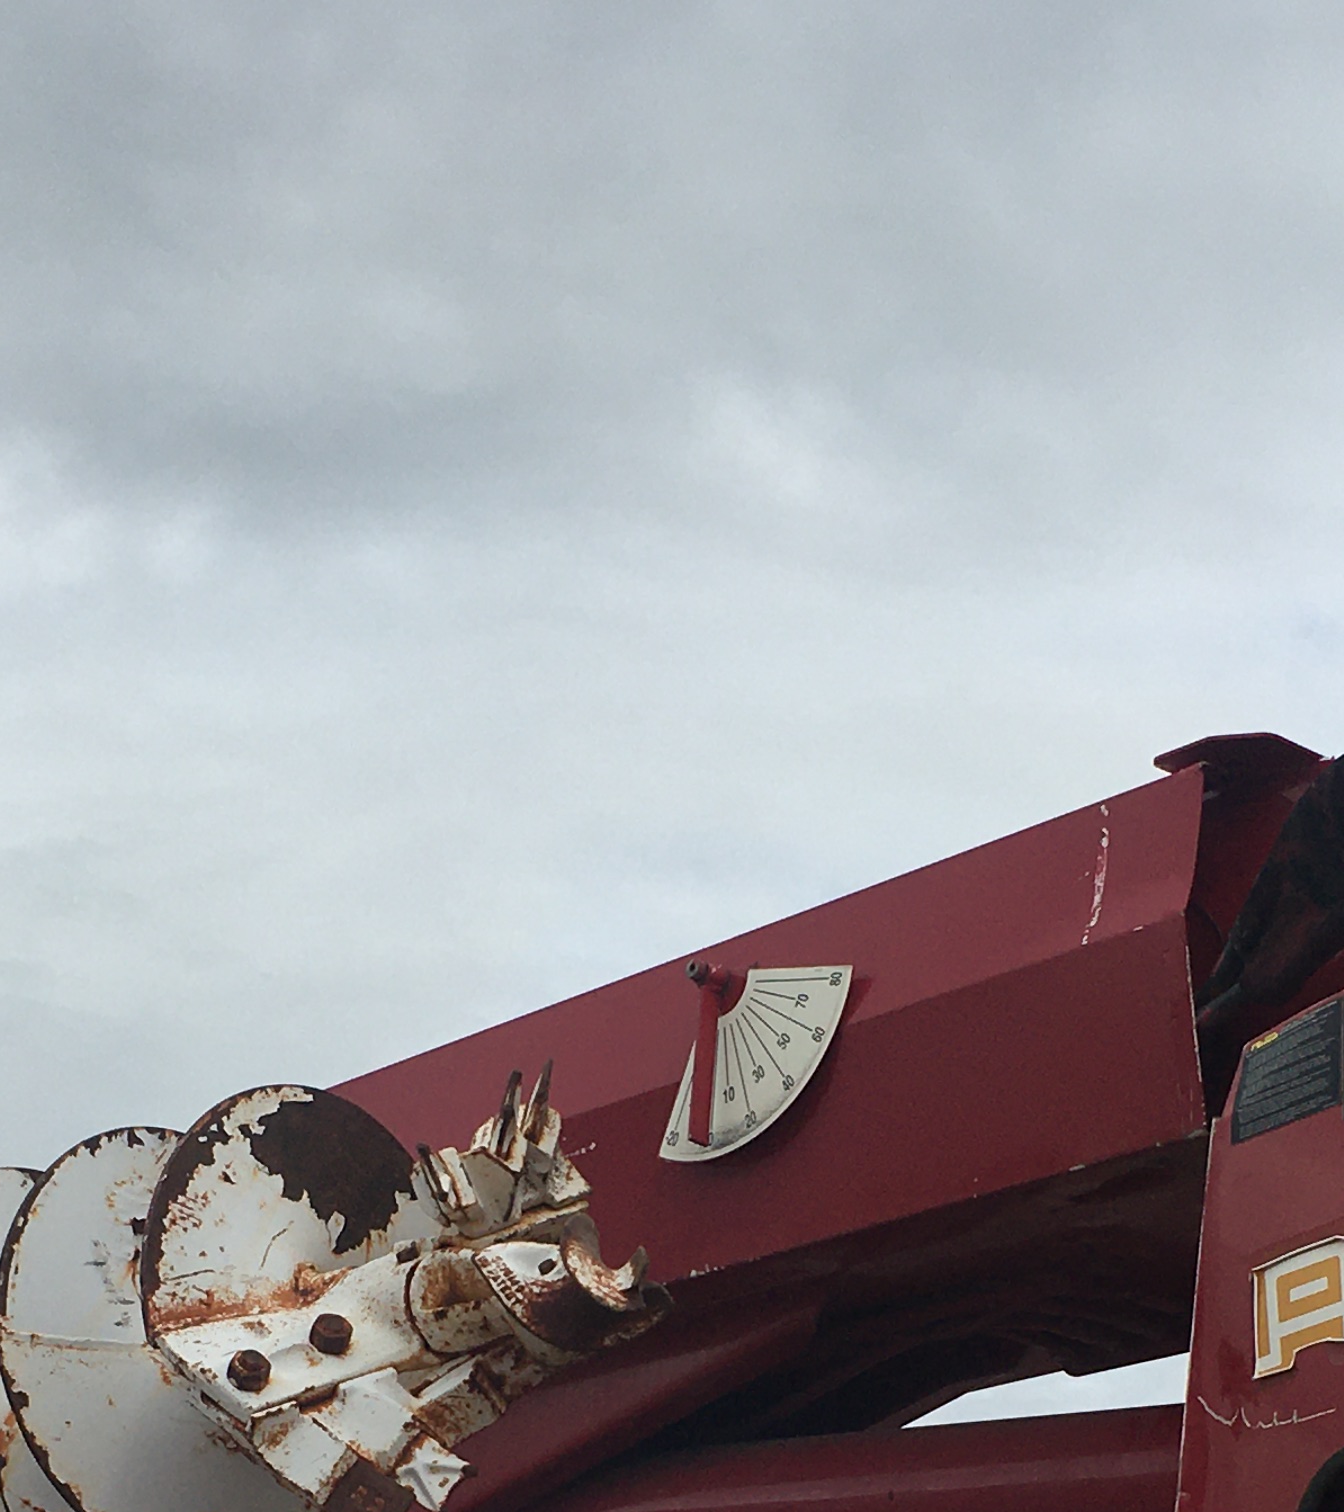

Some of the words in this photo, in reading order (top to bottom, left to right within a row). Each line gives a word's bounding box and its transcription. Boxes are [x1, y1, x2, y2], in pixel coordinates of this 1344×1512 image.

[829, 972, 842, 986] 80
[795, 994, 809, 1009] 70
[777, 1033, 790, 1050] 50
[812, 1027, 825, 1042] 60
[752, 1065, 765, 1083] 30
[782, 1075, 795, 1092] 40
[723, 1087, 735, 1103] 10
[745, 1111, 757, 1128] 20
